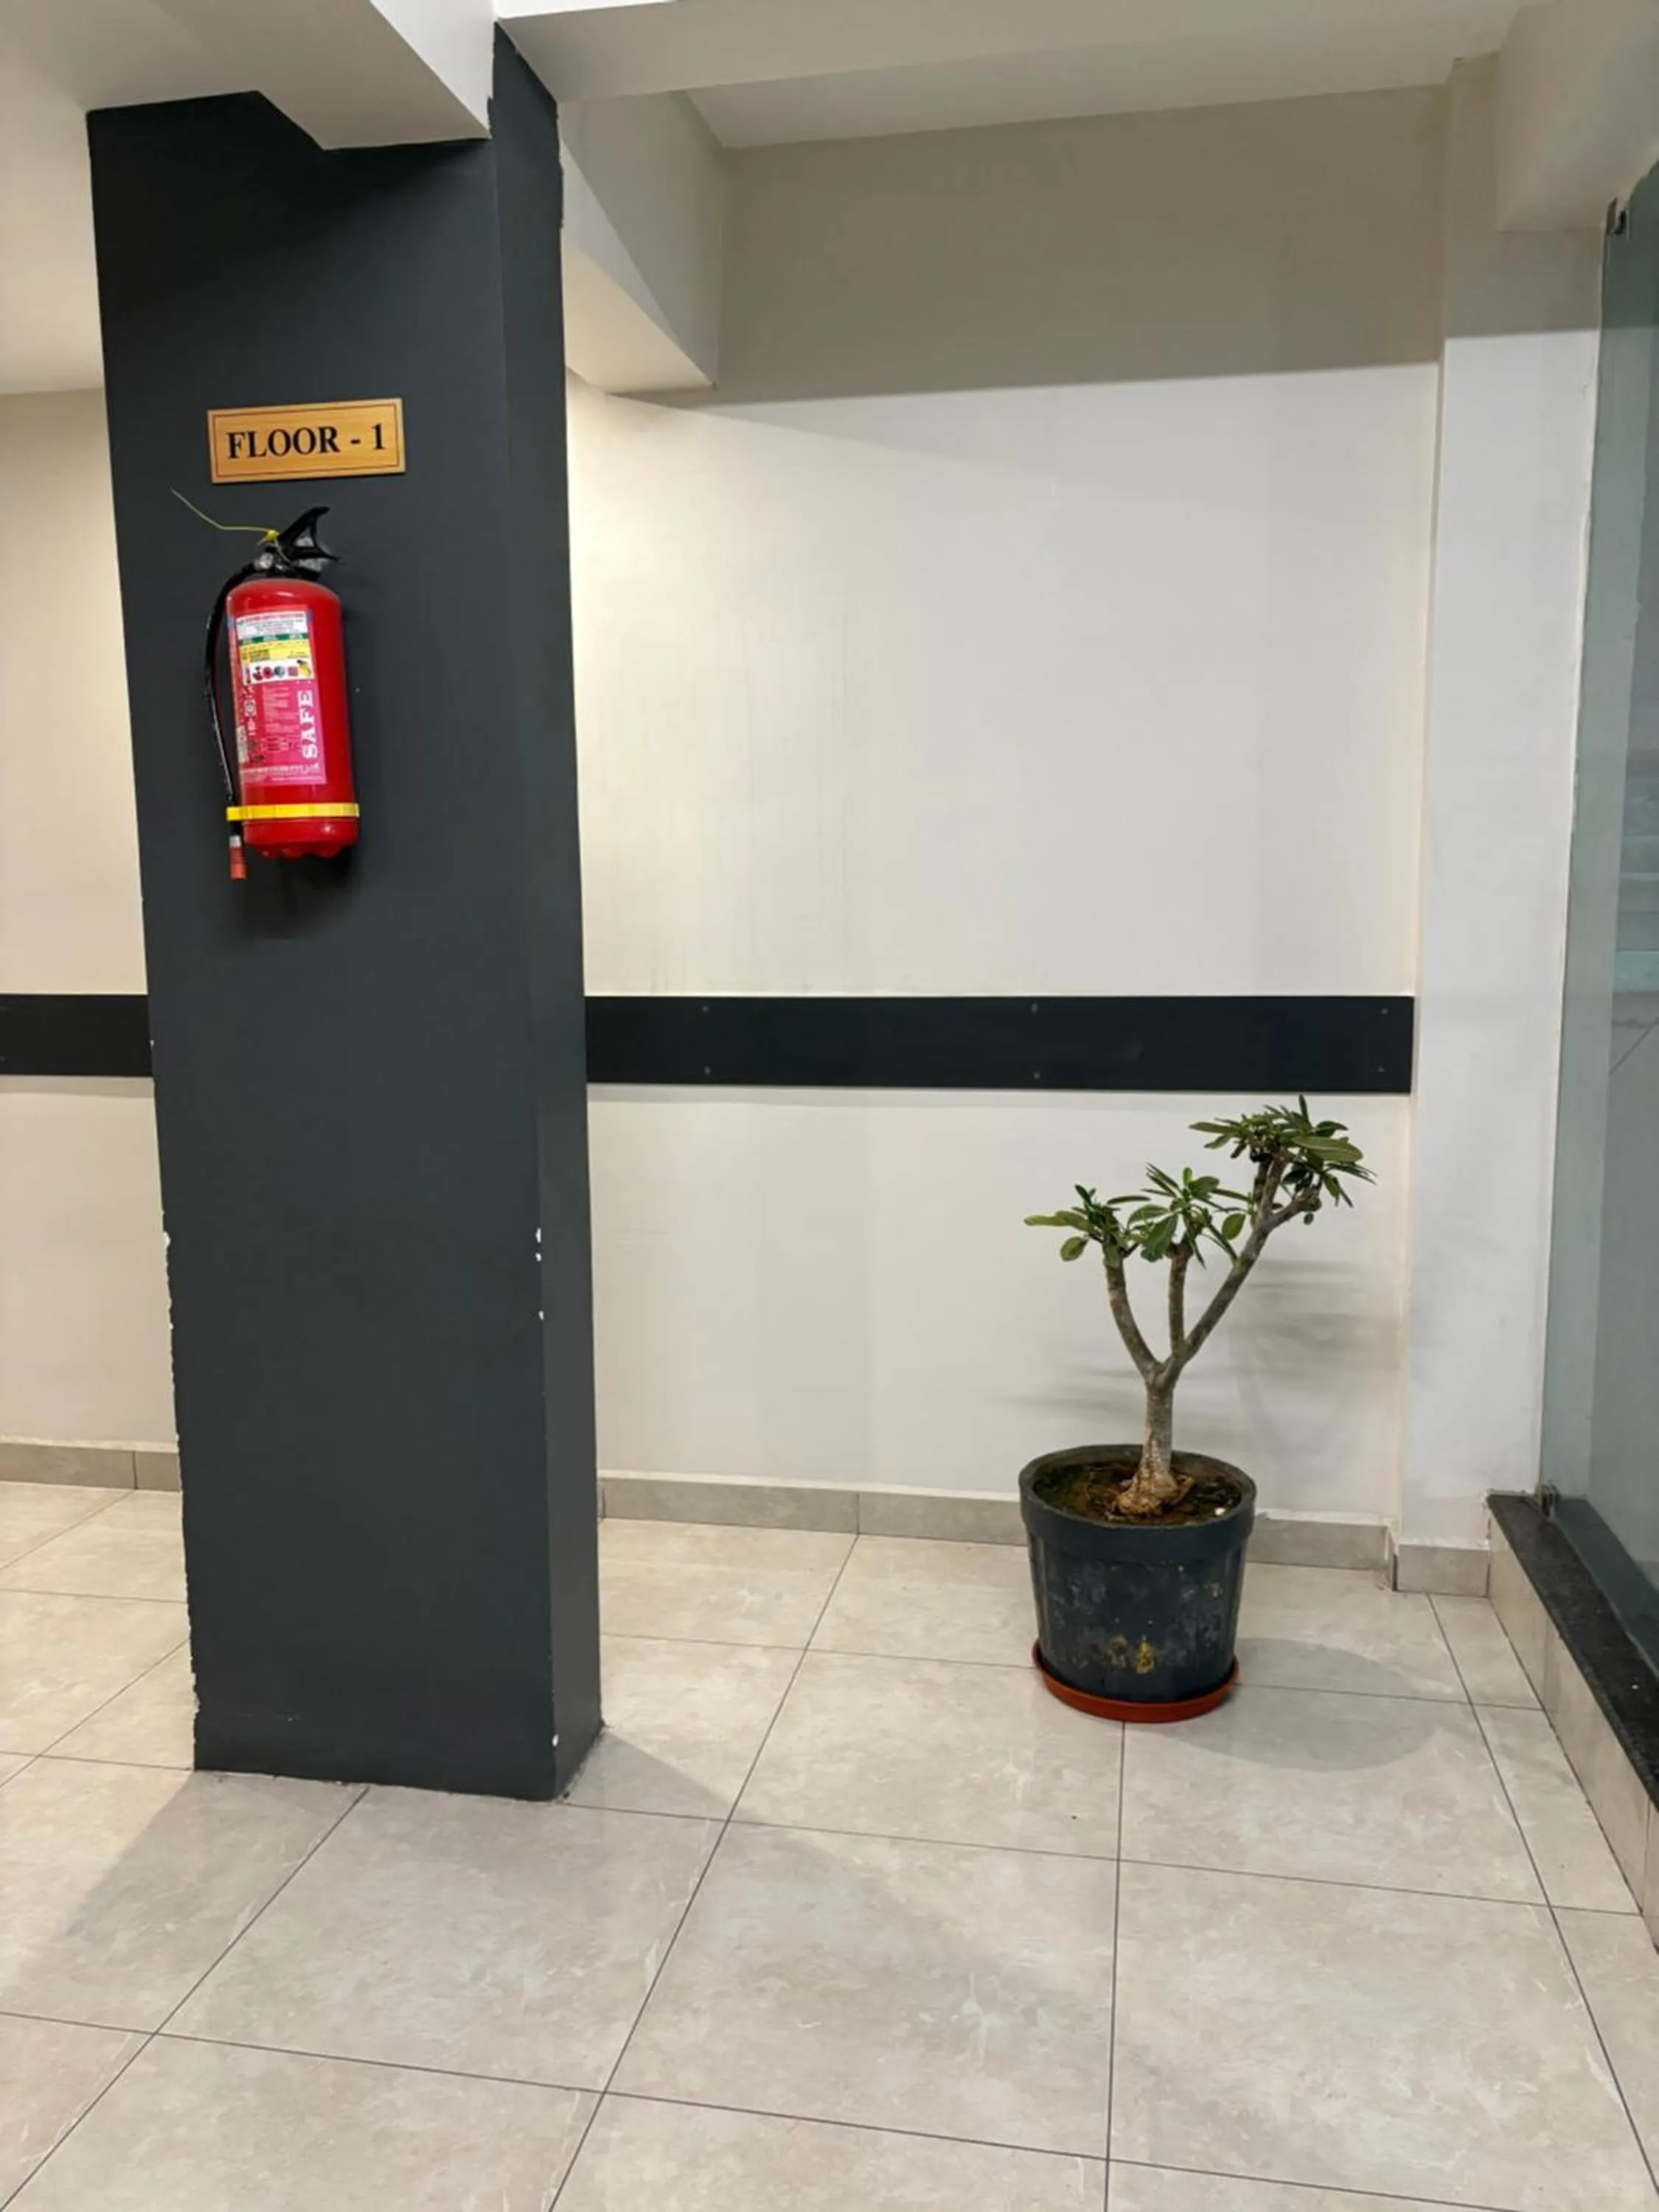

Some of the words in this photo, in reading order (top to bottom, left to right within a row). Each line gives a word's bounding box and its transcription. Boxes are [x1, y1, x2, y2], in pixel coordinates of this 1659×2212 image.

[227, 425, 341, 459] FLOOR
[372, 423, 386, 450] 1
[297, 689, 319, 759] SAFE
